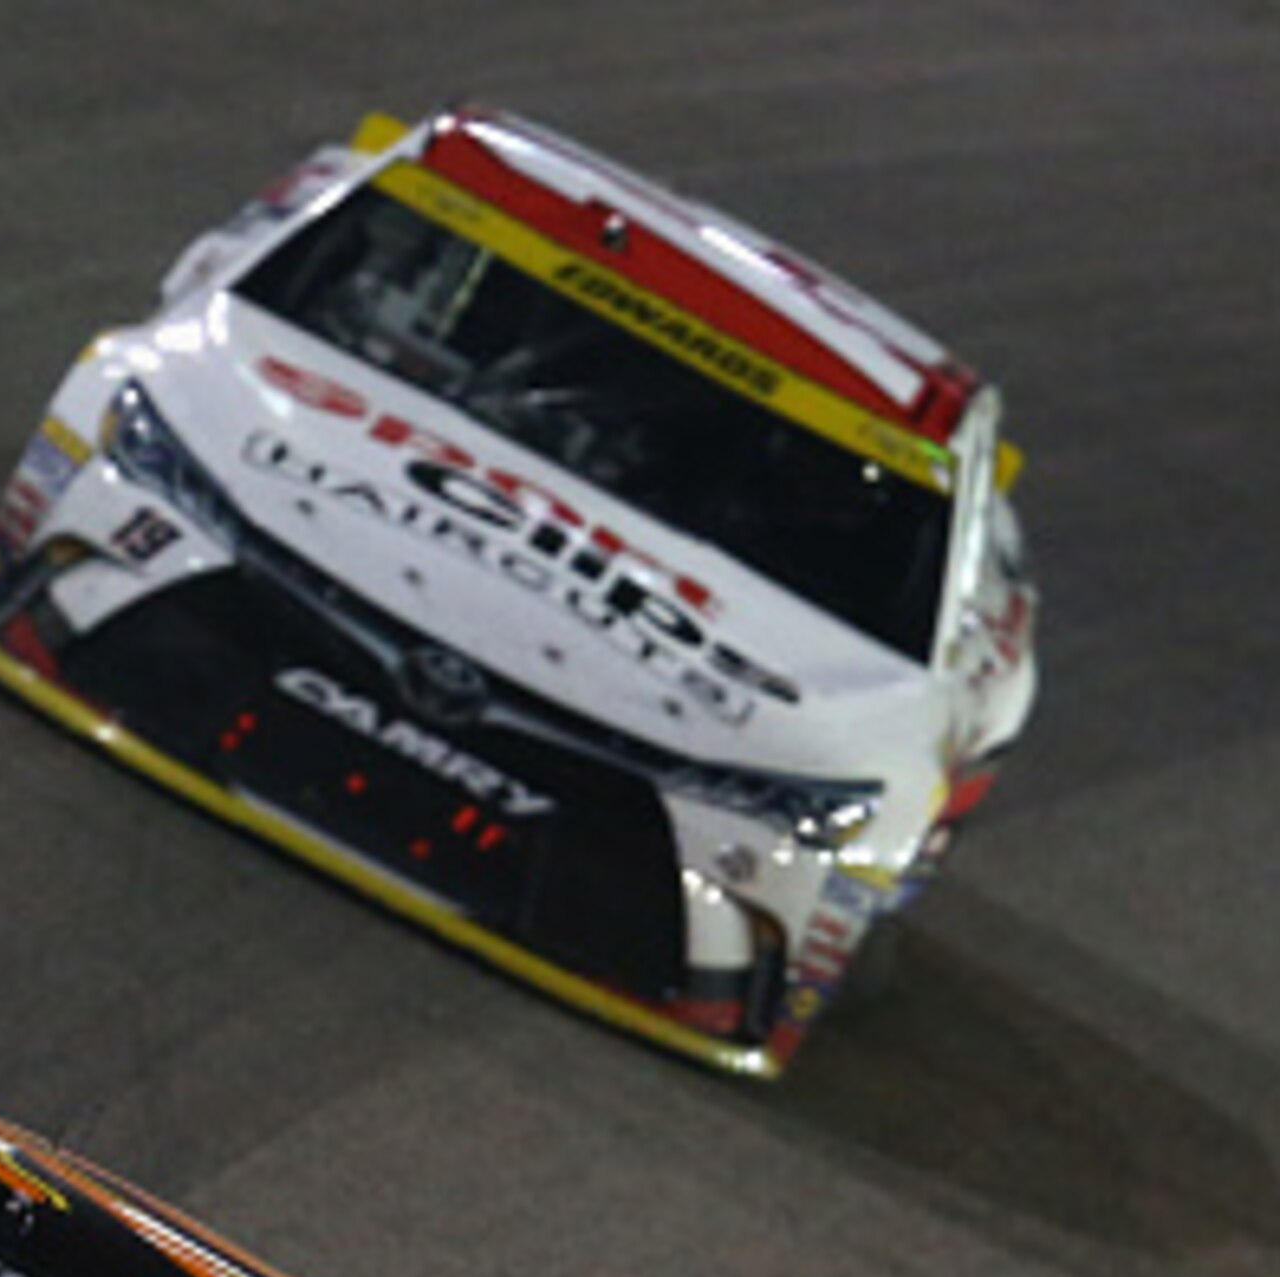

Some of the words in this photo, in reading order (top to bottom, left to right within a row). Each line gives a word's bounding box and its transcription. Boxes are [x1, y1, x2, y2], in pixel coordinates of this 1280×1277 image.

[552, 262, 783, 397] EDWARDS
[110, 505, 184, 563] 19
[266, 440, 732, 706] HAIRCUTS
[272, 666, 553, 818] CAMRY
